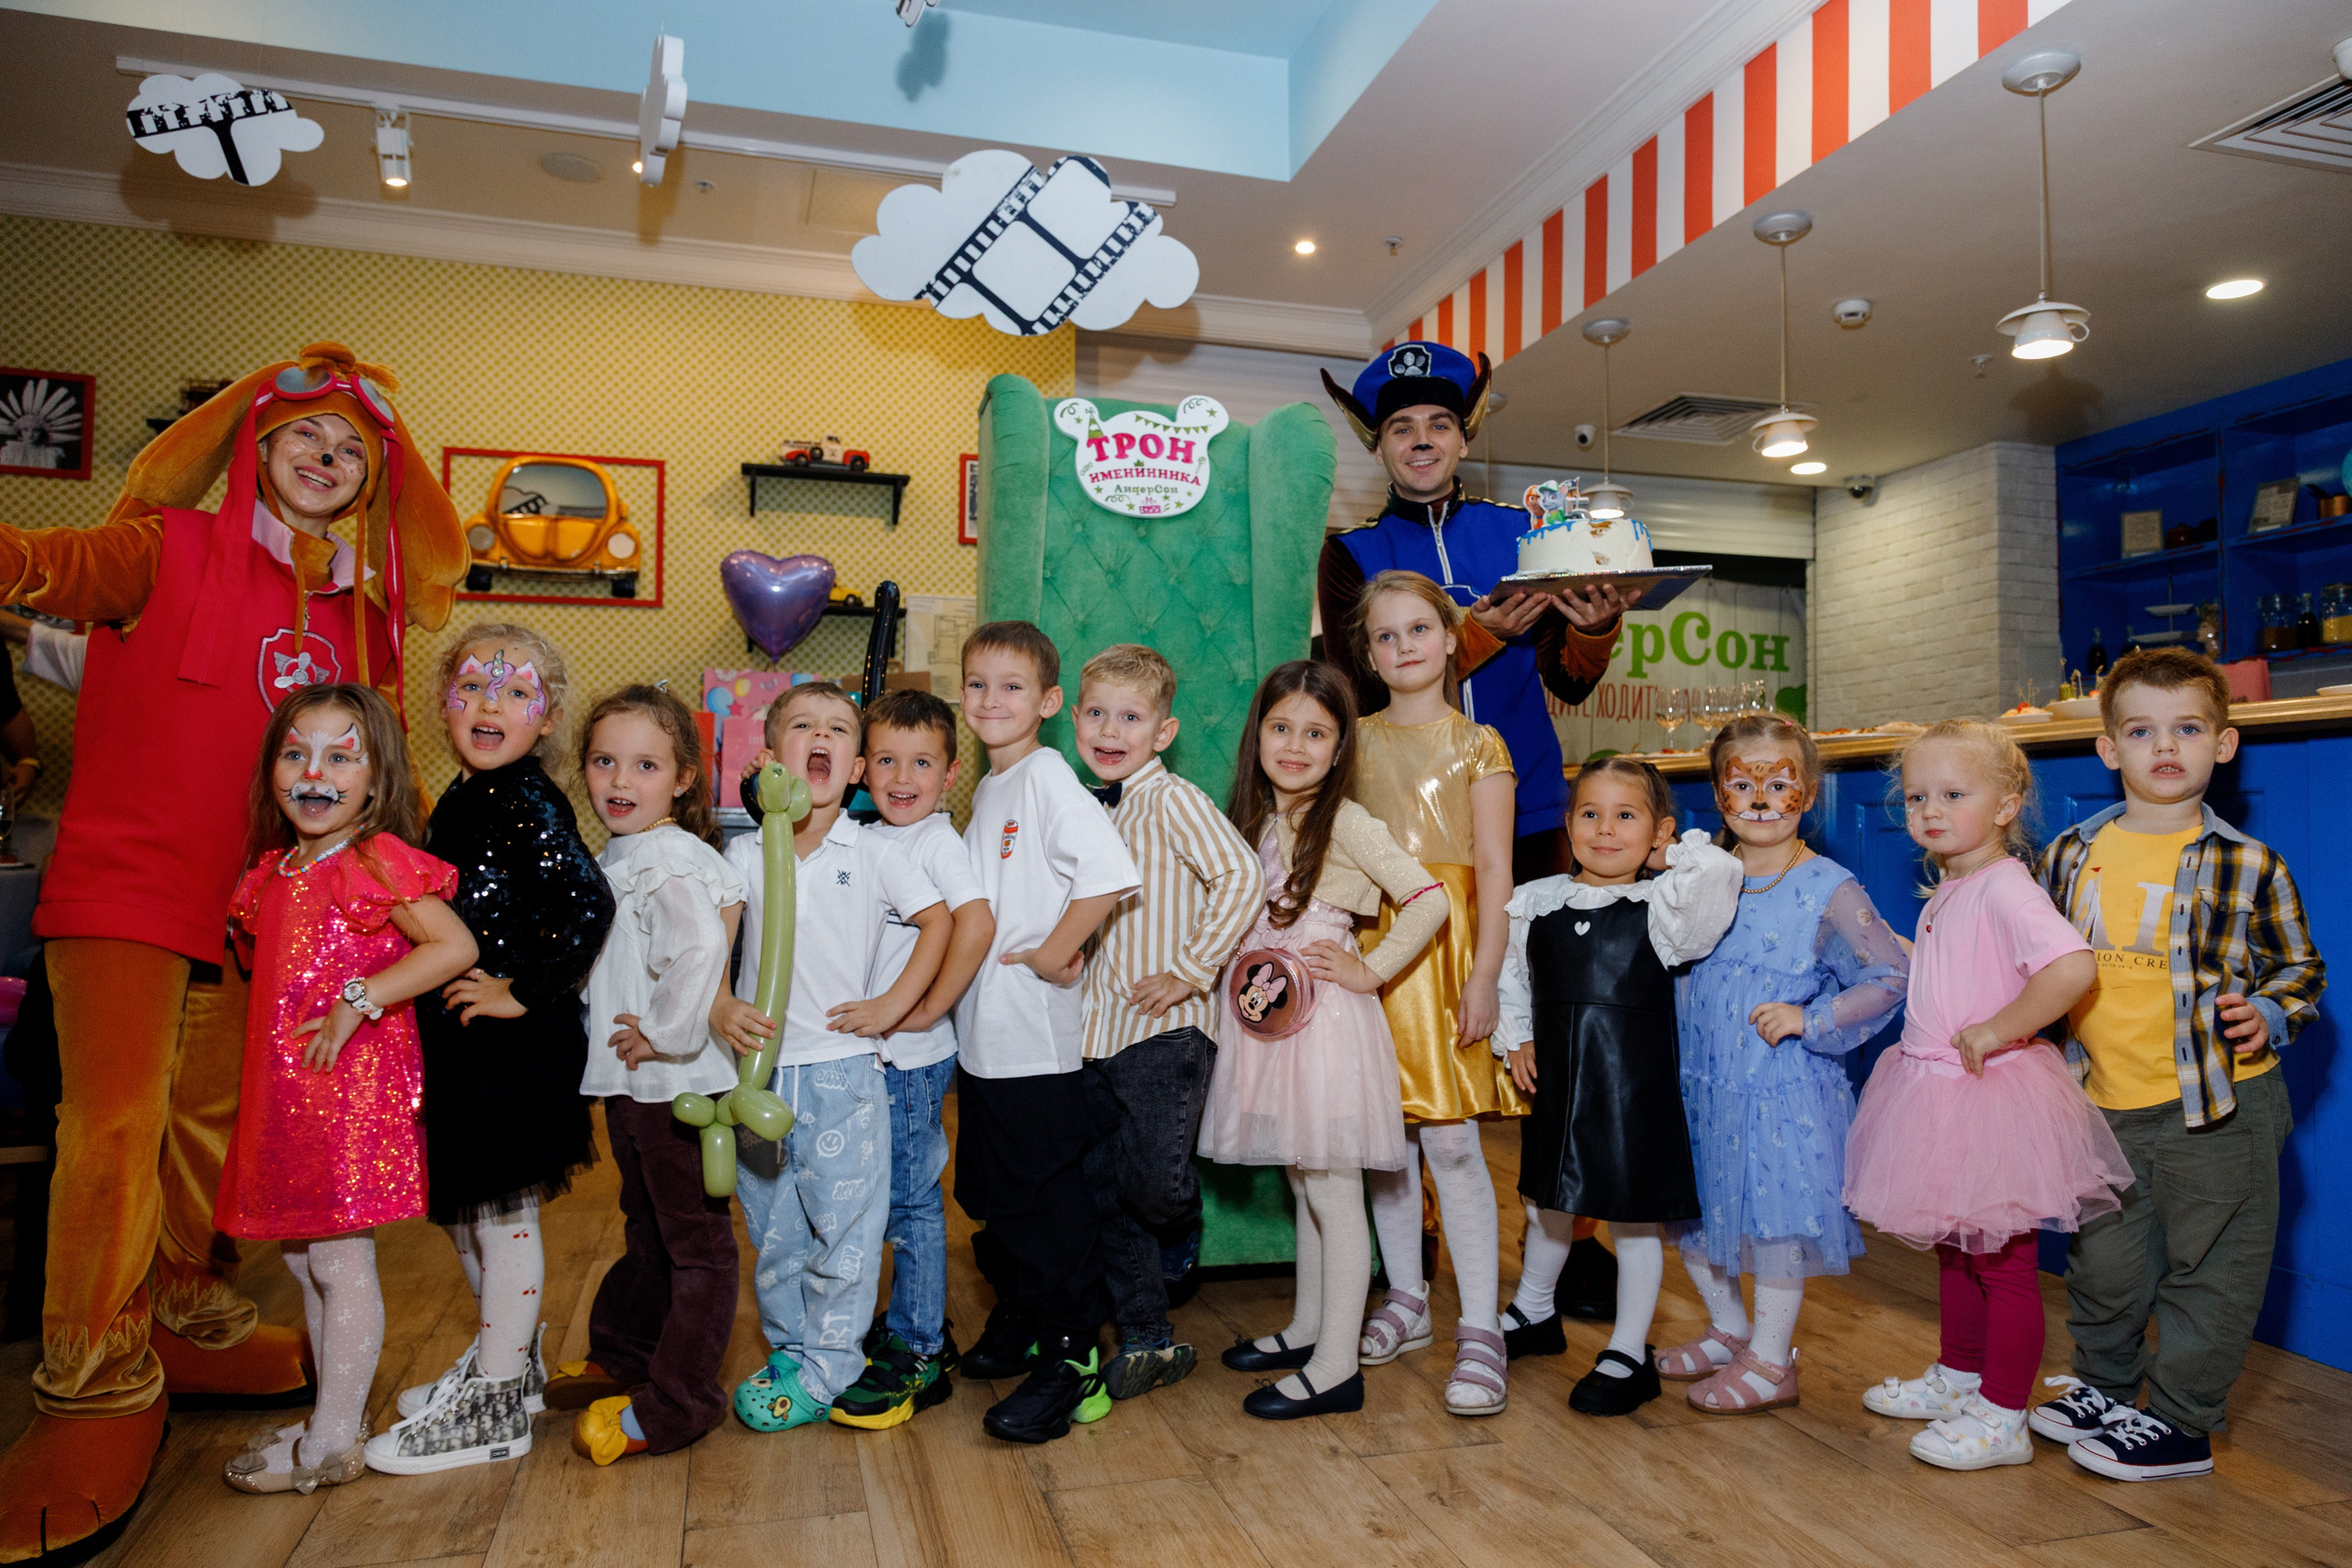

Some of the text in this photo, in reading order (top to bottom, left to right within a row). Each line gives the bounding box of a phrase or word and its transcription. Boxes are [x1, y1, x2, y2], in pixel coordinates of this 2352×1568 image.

[1087, 433, 1196, 464] ТРОН
[1090, 468, 1202, 486] ИМЕНИННИКА
[1596, 682, 1657, 723] ХОДИТ
